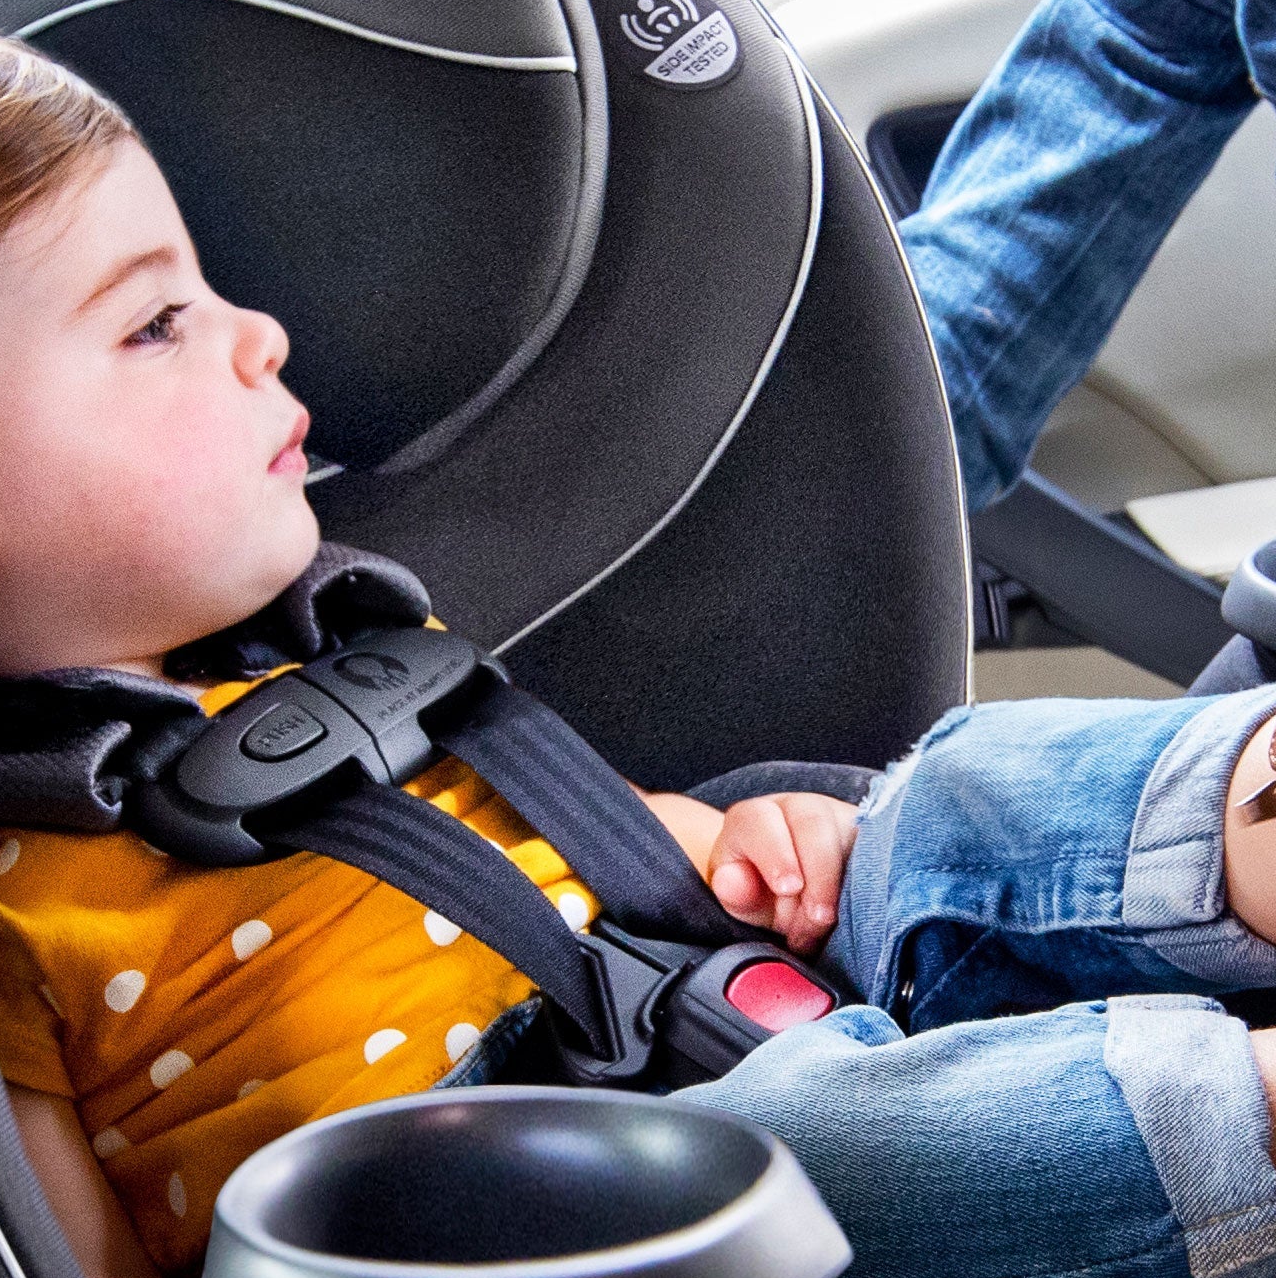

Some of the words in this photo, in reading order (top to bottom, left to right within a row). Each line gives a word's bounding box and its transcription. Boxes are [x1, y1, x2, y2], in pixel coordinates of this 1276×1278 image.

[657, 49, 690, 77] SIDE
[685, 20, 724, 55] IMPACT
[683, 41, 728, 76] TESTED
